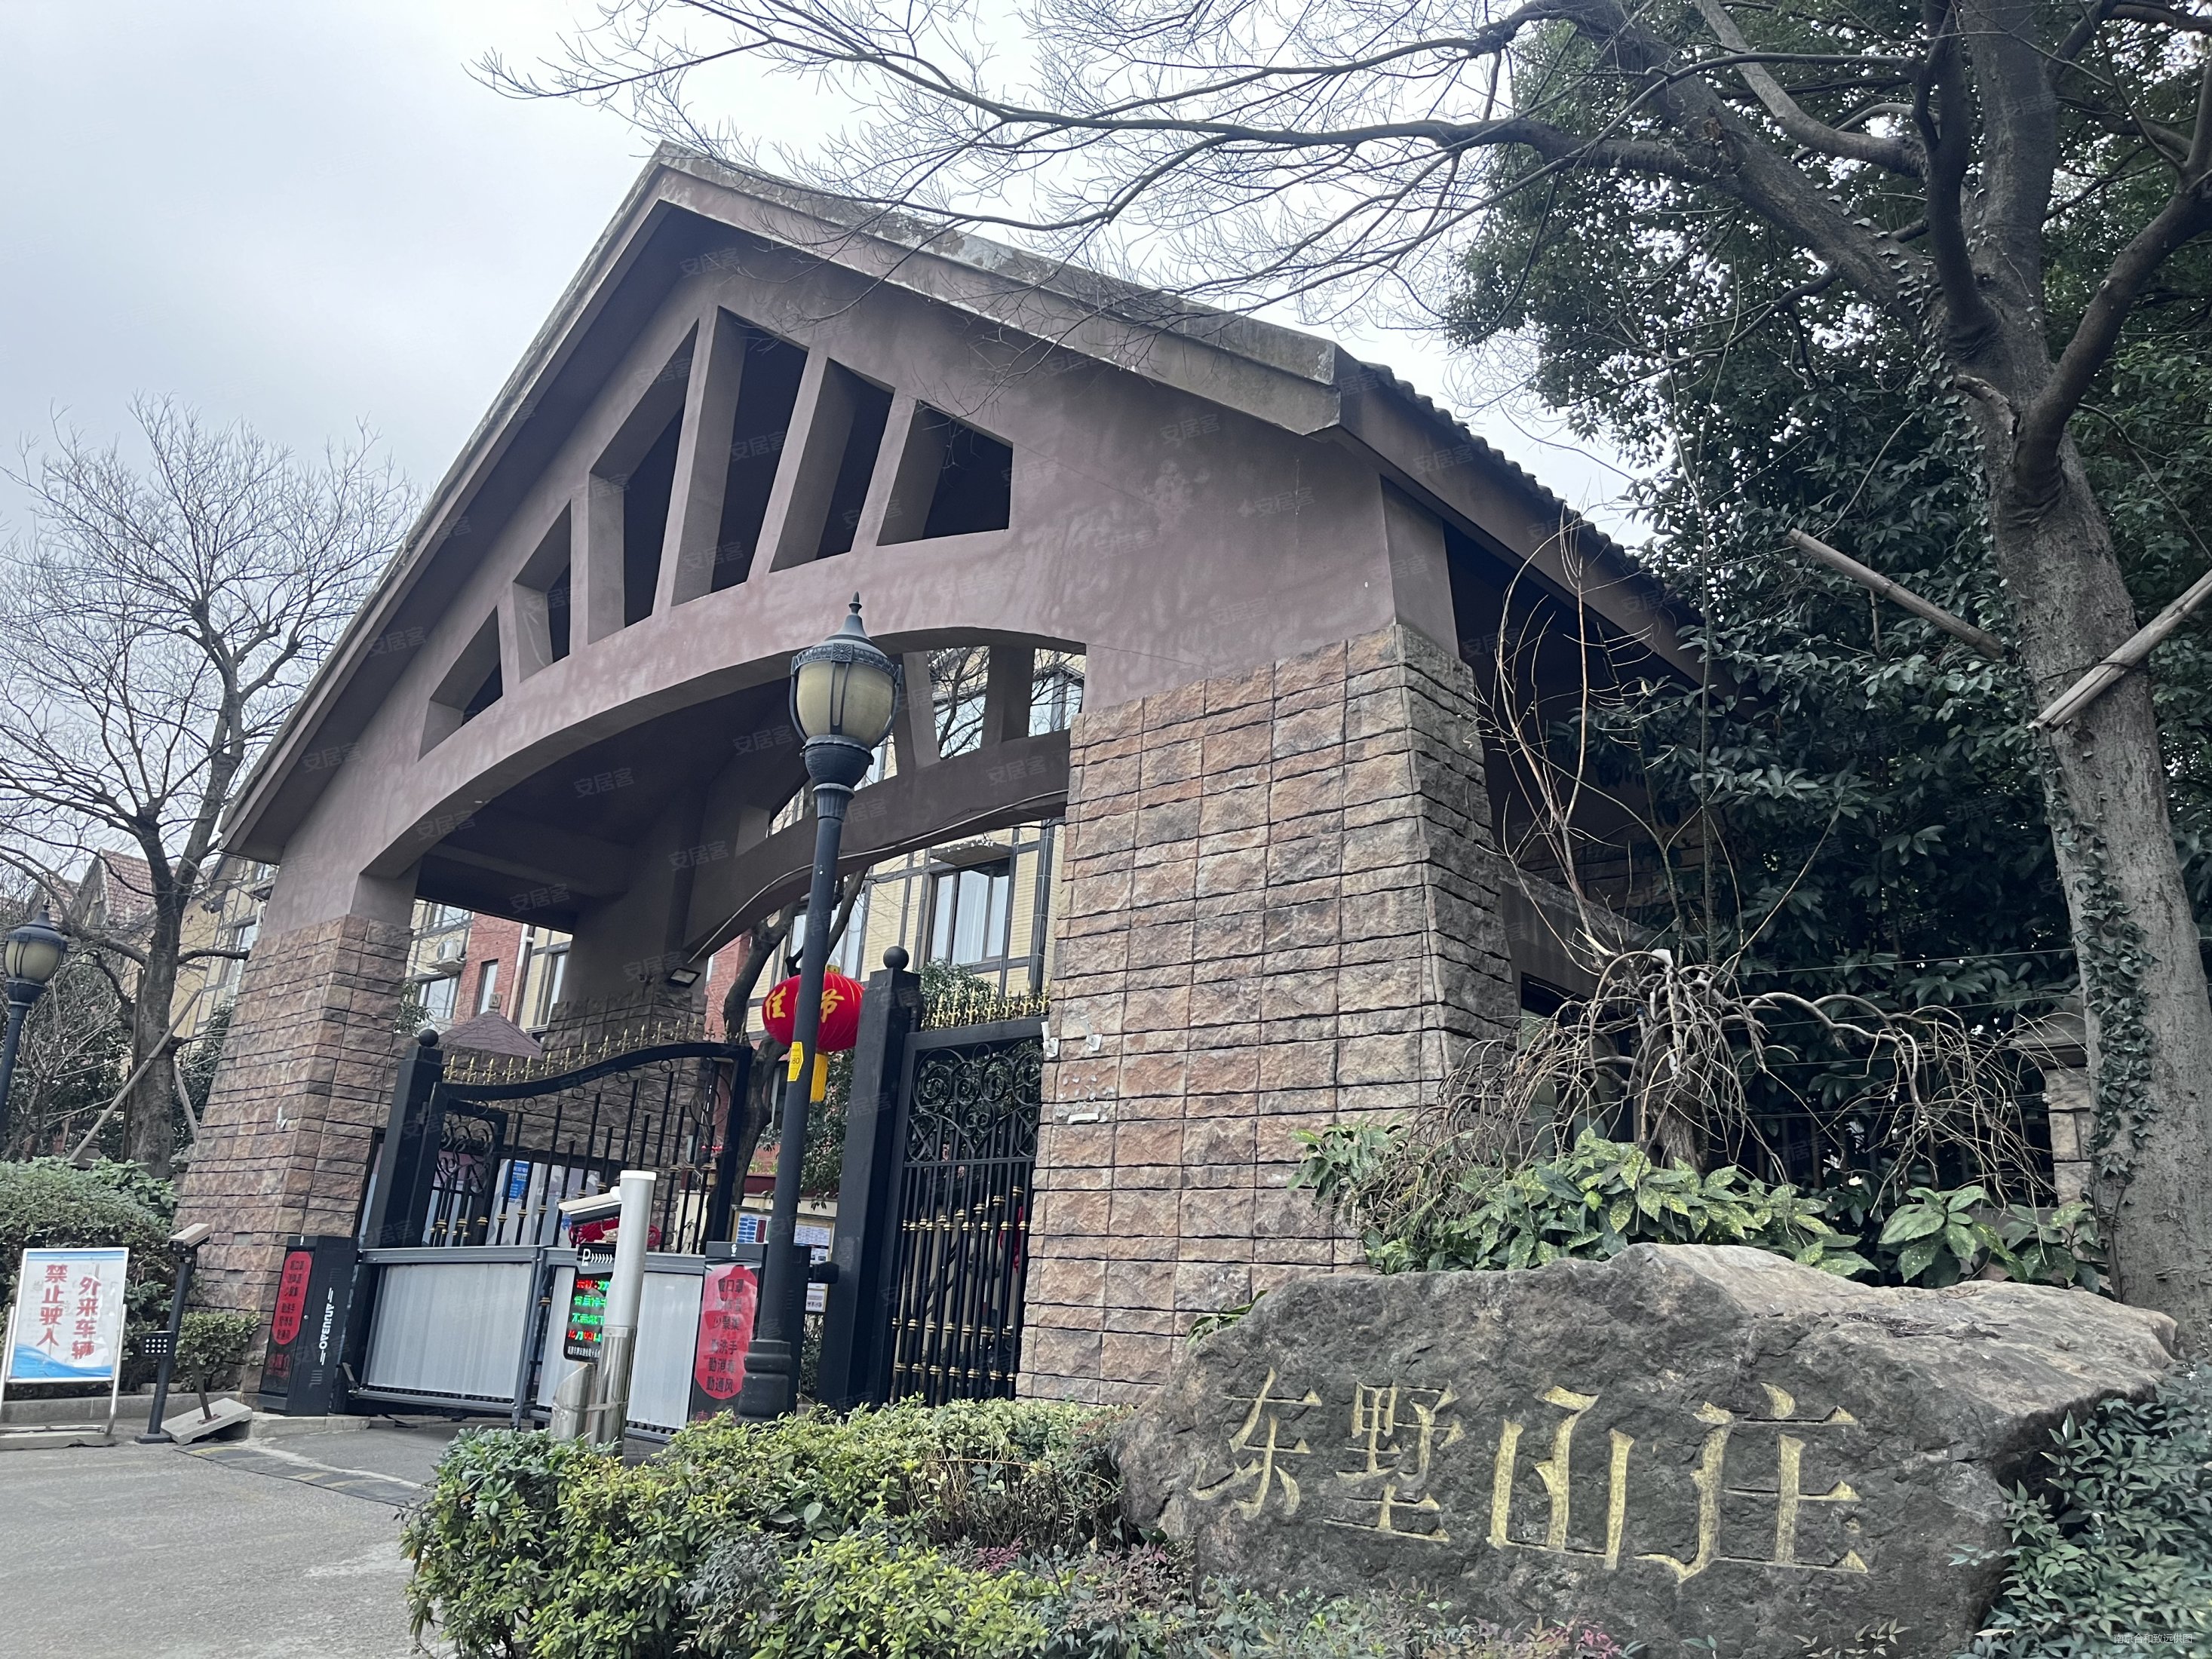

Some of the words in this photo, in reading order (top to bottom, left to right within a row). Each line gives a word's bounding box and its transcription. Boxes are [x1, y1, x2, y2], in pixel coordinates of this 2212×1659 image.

[72, 1276, 102, 1360] 外来车辆
[319, 1303, 335, 1350] ANJUBAO
[706, 1375, 734, 1394] 勤通风
[1189, 1366, 1869, 1583] 东墅山庄
